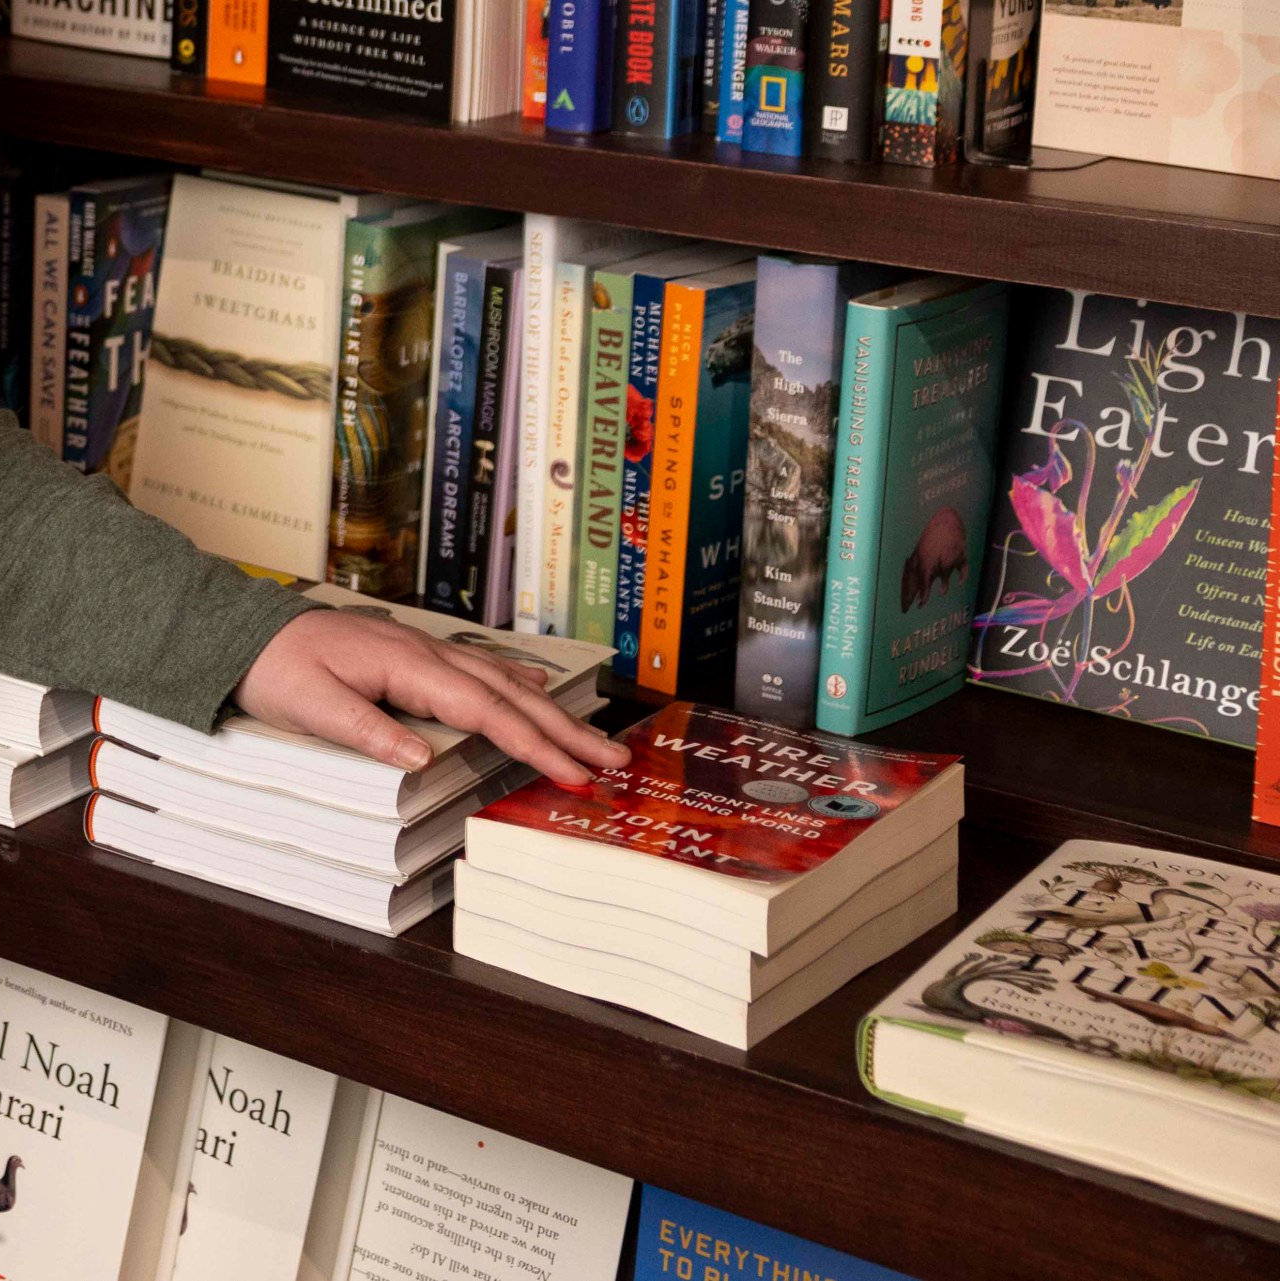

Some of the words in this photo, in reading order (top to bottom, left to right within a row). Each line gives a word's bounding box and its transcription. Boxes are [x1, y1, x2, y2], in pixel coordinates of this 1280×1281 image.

[627, 29, 655, 85] BOOK
[210, 259, 306, 292] BRAIDING
[192, 291, 317, 332] SWEETGRASS
[849, 335, 872, 447] VANISHING
[587, 326, 624, 551] BEAVERLAND
[663, 396, 683, 492] SPYING
[839, 456, 862, 562] TREASURES
[654, 529, 673, 631] WHALES
[764, 565, 793, 583] Kim
[748, 616, 806, 642] Robinson
[754, 590, 801, 615] Stanley
[999, 625, 1072, 667] Zoë
[652, 733, 881, 798] WEATHER
[730, 734, 841, 769] FIRE
[547, 810, 741, 867] VAILLANT
[605, 809, 713, 844] JOHN
[23, 1030, 122, 1110] Noah
